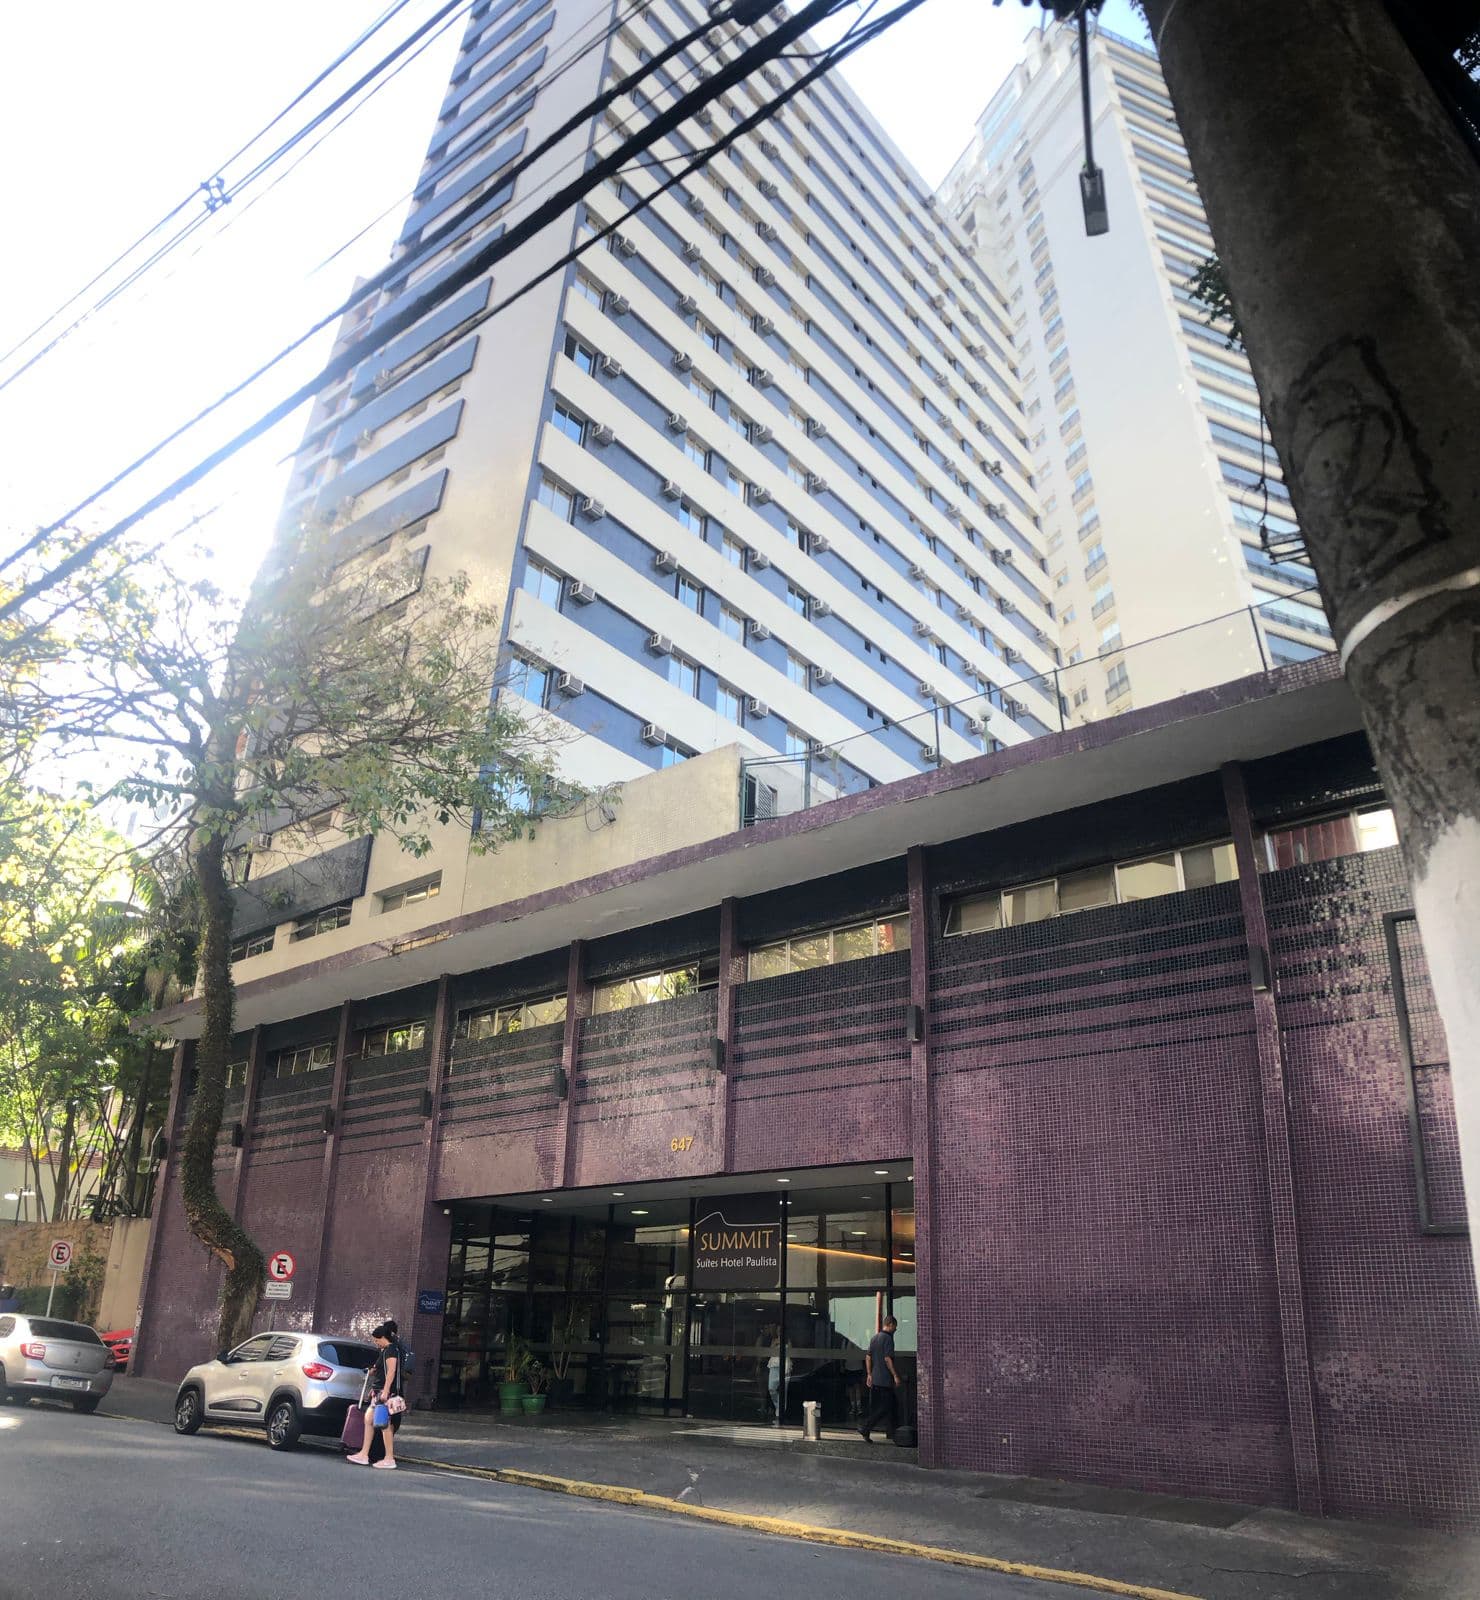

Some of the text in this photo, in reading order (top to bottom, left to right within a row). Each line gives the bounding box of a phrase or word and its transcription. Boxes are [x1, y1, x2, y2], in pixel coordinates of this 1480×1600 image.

[671, 1136, 694, 1151] 647
[700, 1230, 774, 1251] SUMMIT
[56, 1246, 66, 1261] E
[277, 1258, 288, 1275] E
[696, 1256, 777, 1268] Suites Hotel Paulista
